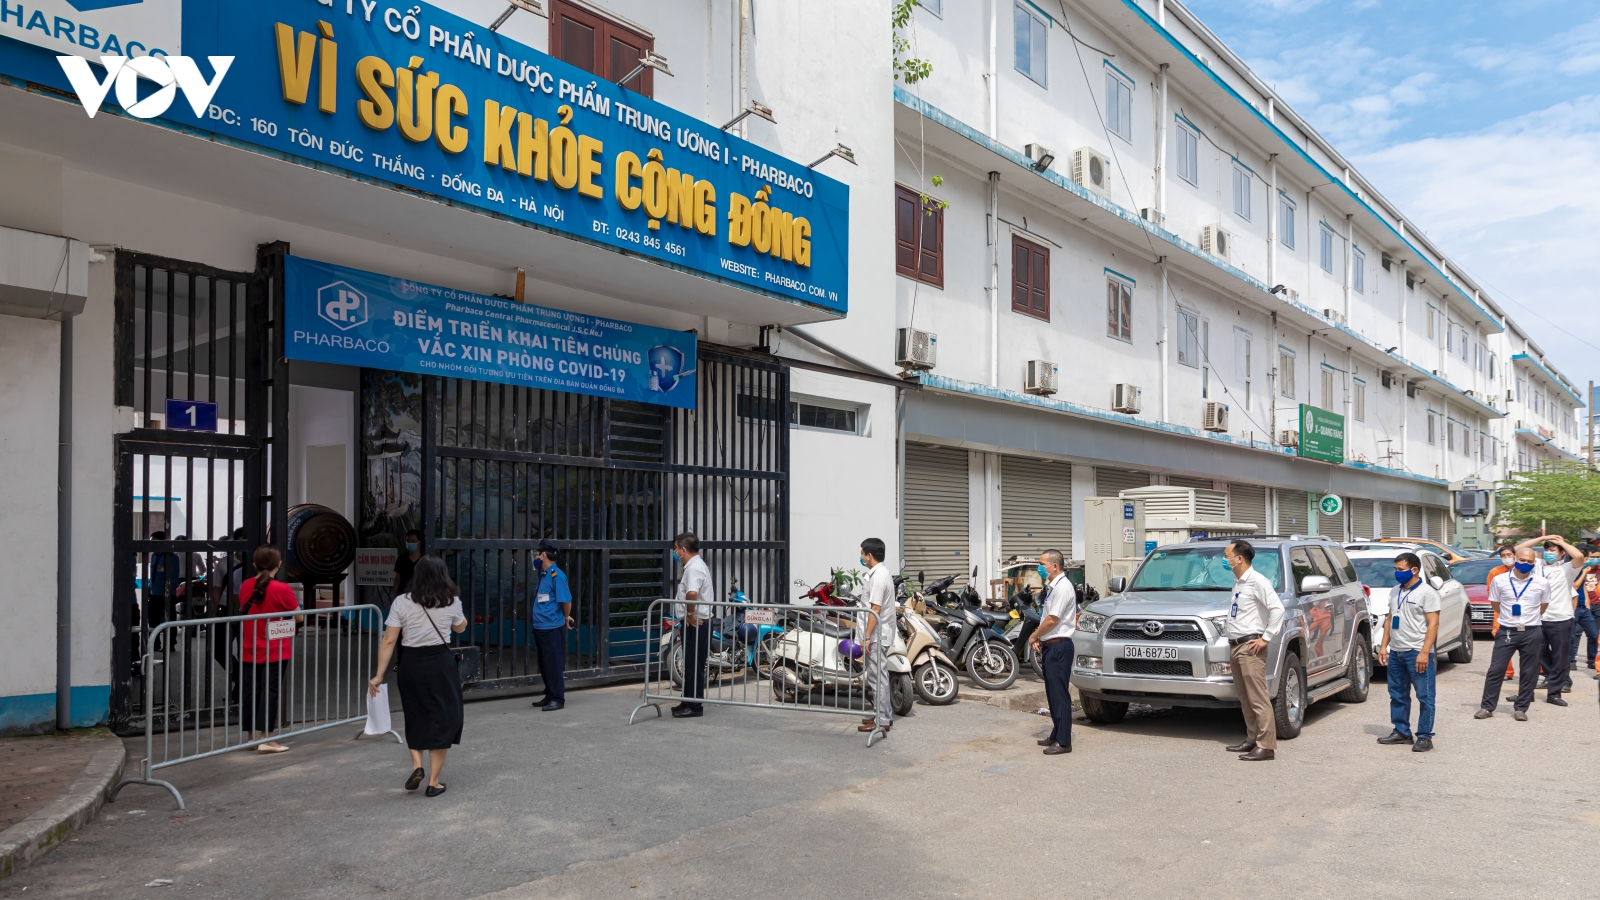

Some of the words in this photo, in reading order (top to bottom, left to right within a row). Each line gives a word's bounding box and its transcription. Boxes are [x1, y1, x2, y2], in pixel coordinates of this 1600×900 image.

[384, 5, 421, 40] CỔ
[429, 24, 491, 69] PHẦN
[497, 52, 554, 93] DƯỢC
[558, 80, 610, 117] PHẨM
[614, 101, 671, 142] TRUNG
[676, 127, 720, 162] ƯƠNG
[741, 155, 813, 199] PHARBACO
[208, 104, 241, 127] ĐC:
[250, 117, 278, 137] 160
[287, 127, 323, 151] TÔN
[329, 140, 364, 163] ĐỨC
[372, 153, 425, 181] THẮNG
[441, 173, 482, 197] ĐỐNG
[486, 187, 505, 204] ĐA
[543, 204, 565, 222] NỘI
[274, 19, 337, 115] VÌ
[355, 54, 469, 154] SỨC
[483, 99, 603, 199] KHỎE
[615, 148, 717, 237] CỘNG
[728, 185, 812, 268] ĐỒNG
[592, 219, 610, 235] ĐT:
[615, 227, 640, 244] 0243
[643, 235, 661, 250] 845
[664, 241, 686, 257] 4561
[720, 257, 760, 279] WEBSITE:
[828, 290, 838, 302] VN
[402, 283, 429, 295] CÔNG
[431, 288, 442, 297] TY
[484, 298, 509, 310] DƯỢC
[536, 307, 562, 319] TRUNG
[563, 313, 585, 323] ƯƠNG
[595, 319, 633, 333] PHARBACO
[445, 302, 483, 316] Pharbaco
[485, 310, 514, 322] Central
[515, 315, 571, 332] Pharmaceutical
[293, 330, 390, 354] PHARBACO
[393, 308, 443, 333] ĐIỂM
[507, 329, 548, 349] KHAI
[552, 335, 589, 357] TIÊM
[593, 344, 642, 365] CHỦNG
[417, 331, 457, 358] VẮC
[460, 344, 492, 363] XIN
[497, 349, 555, 372] PHÒNG
[558, 359, 626, 383] COVID-19
[419, 360, 437, 369] CHO
[438, 362, 462, 372] NHÓM
[478, 367, 504, 377] TƯỢNG
[505, 370, 516, 379] ƯU
[517, 372, 533, 381] TIÊN
[535, 375, 552, 384] TRÊN
[553, 377, 565, 387] ĐỊA
[566, 379, 580, 388] BÀN
[580, 381, 598, 390] QUẬN
[186, 406, 196, 426] 1
[358, 553, 369, 565] CẤM
[370, 555, 380, 566] MỌI
[1126, 646, 1177, 659] 30A-687.50
